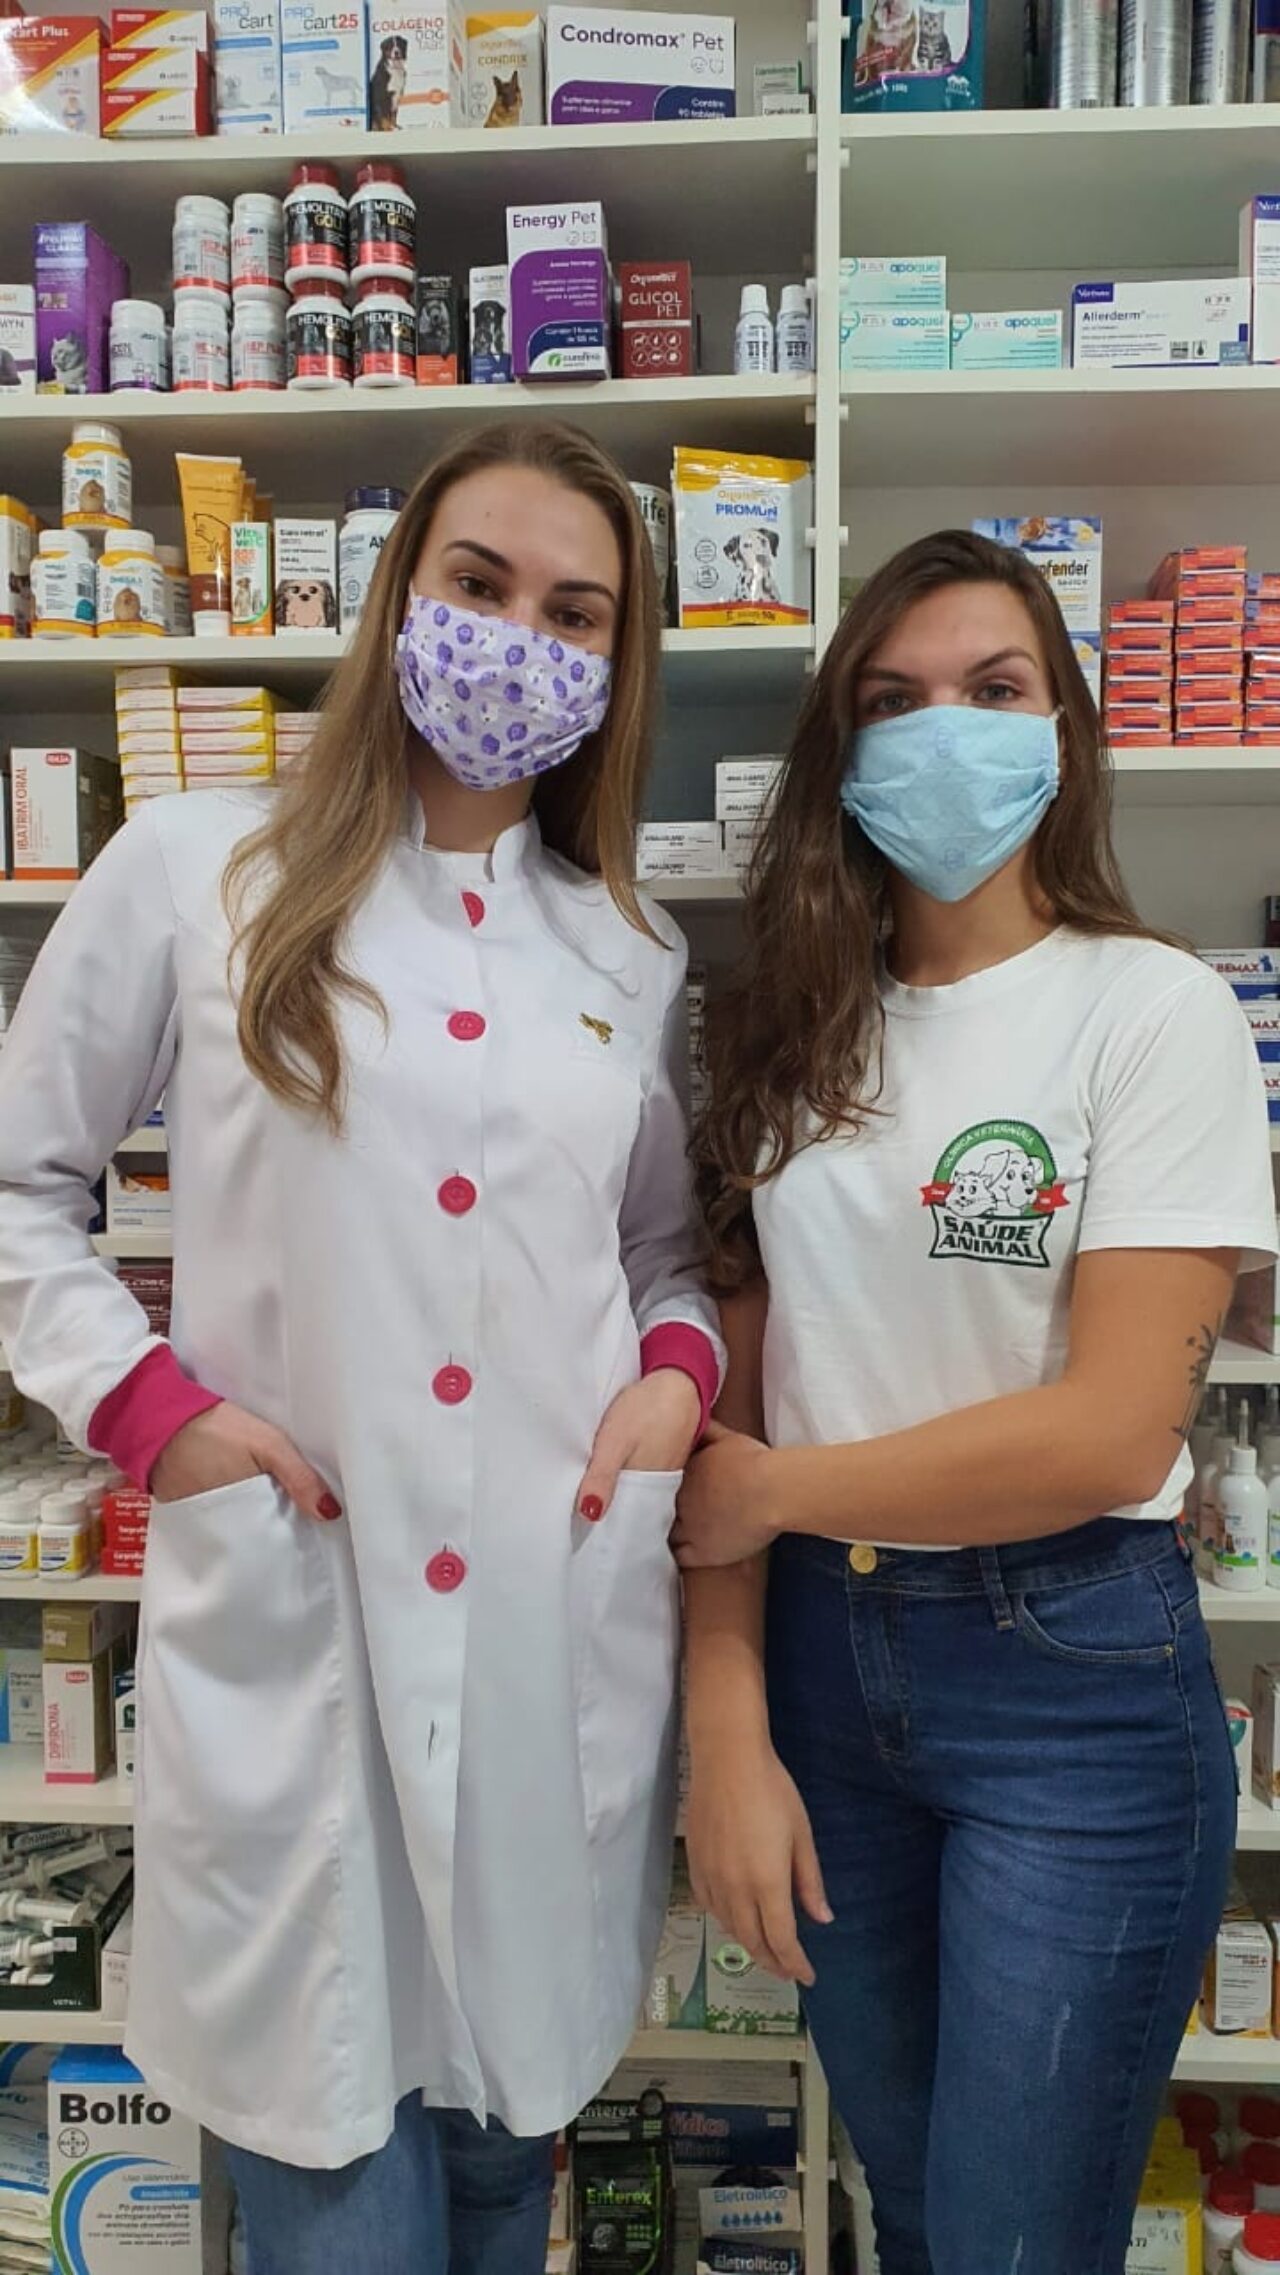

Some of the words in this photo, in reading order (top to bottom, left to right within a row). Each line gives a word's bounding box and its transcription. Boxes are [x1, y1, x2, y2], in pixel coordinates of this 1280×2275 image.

[42, 24, 70, 37] Plus
[238, 14, 275, 29] cart
[414, 28, 444, 41] DOG
[691, 32, 725, 52] Pet
[512, 213, 568, 229] Energy
[571, 211, 597, 225] Pet
[628, 291, 684, 306] GLICOL
[656, 303, 683, 318] PET
[298, 312, 349, 331] HEMOLITA
[363, 311, 415, 329] HEMOLITA
[714, 503, 779, 517] PROMUN
[15, 766, 29, 799] ORAL
[15, 801, 29, 851] IBATRIM
[1210, 962, 1259, 974] BEMAX
[942, 1215, 1036, 1242] SAÚDE
[938, 1233, 1041, 1260] ANIMAL
[59, 2092, 172, 2125] Bolfo
[586, 2186, 652, 2206] Enterex
